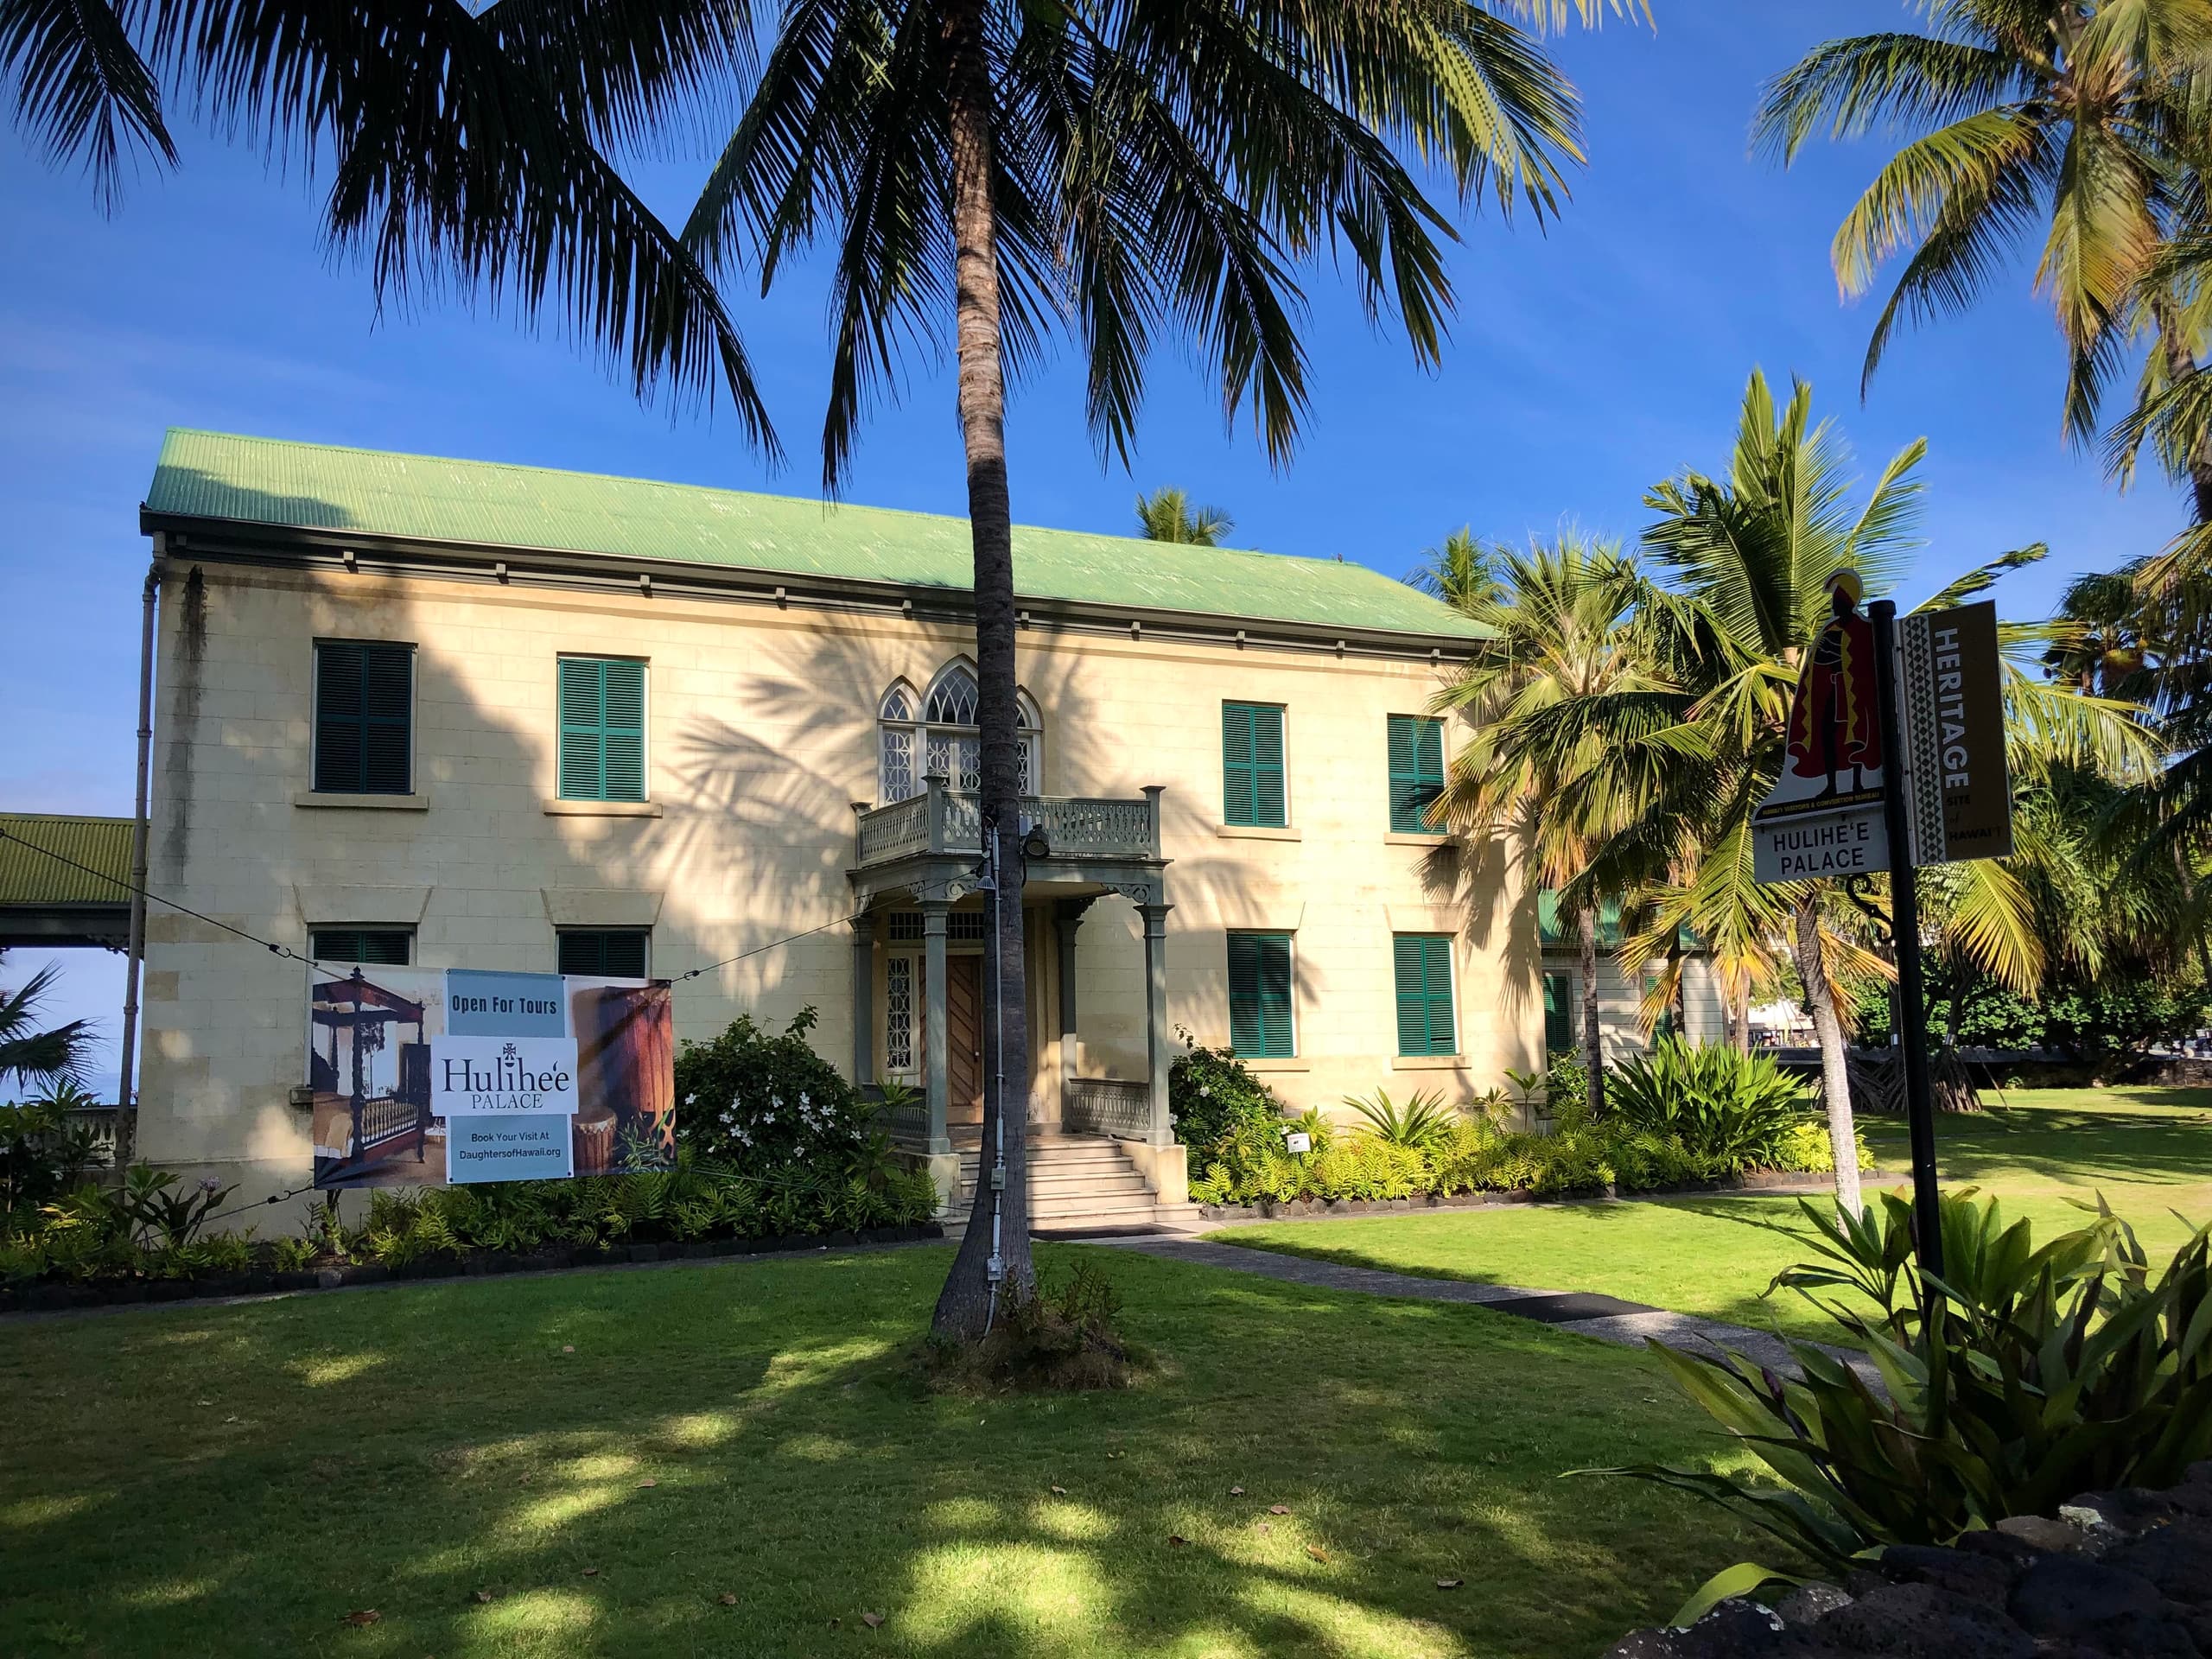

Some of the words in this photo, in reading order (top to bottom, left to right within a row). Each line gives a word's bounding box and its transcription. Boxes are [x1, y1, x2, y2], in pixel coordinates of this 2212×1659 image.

[1935, 628, 1970, 790] HERITAGE
[1947, 795, 1971, 806] SITE
[1781, 848, 1865, 875] PALACE
[452, 995, 486, 1014] Open
[493, 997, 514, 1013] For
[519, 998, 556, 1014] Tours
[472, 1093, 543, 1109] PALACE
[471, 1133, 494, 1142] Book
[496, 1133, 517, 1141] Your
[518, 1132, 537, 1141] Visit
[539, 1131, 550, 1141] At
[460, 1147, 561, 1161] DaughtersofHawaii.org
